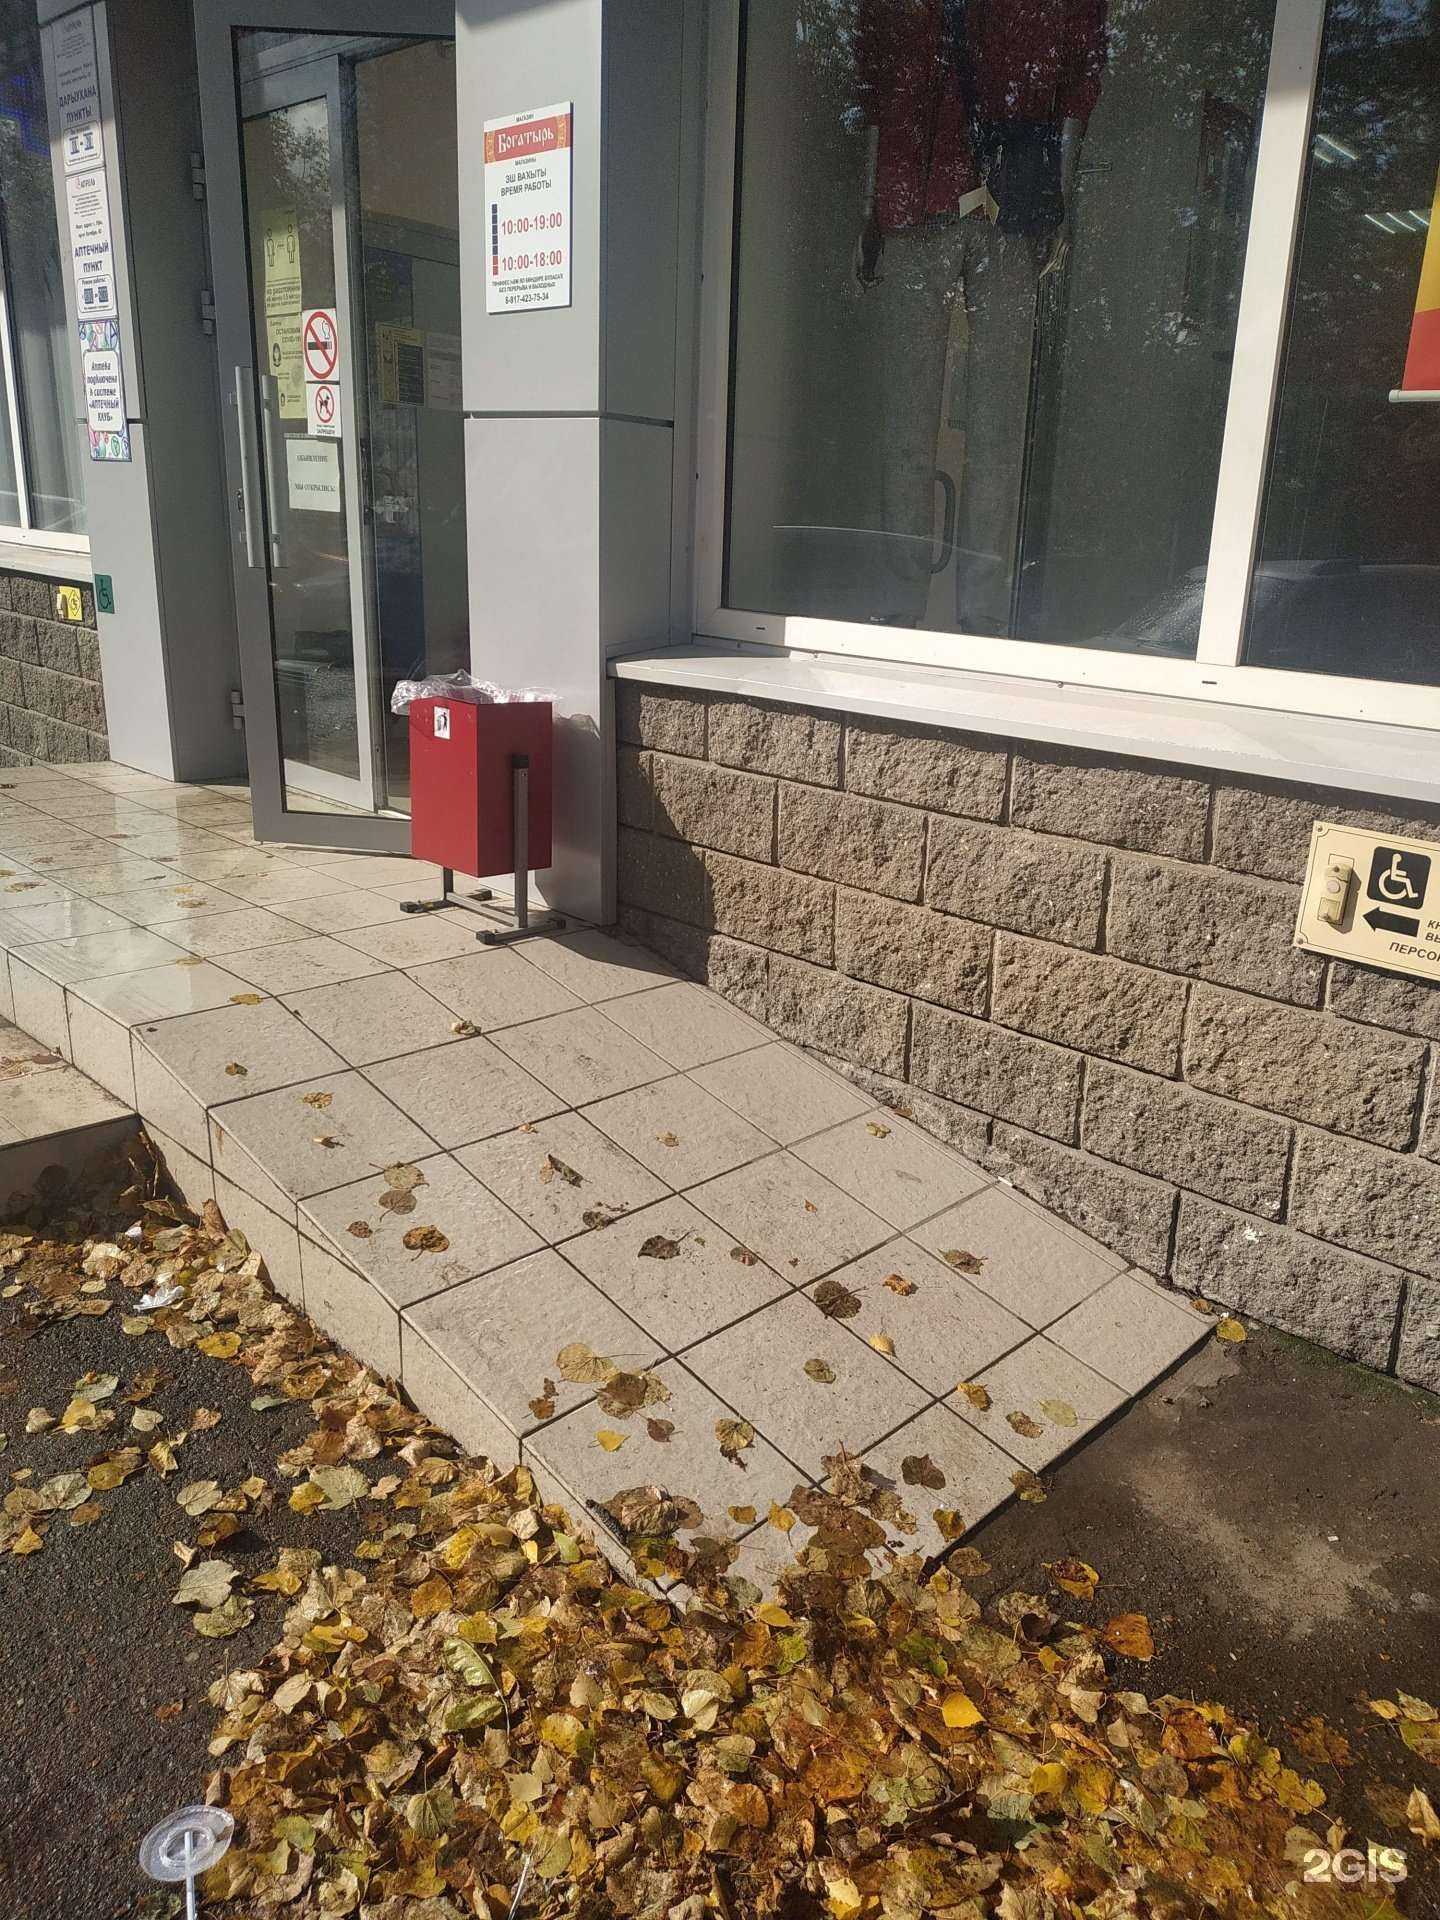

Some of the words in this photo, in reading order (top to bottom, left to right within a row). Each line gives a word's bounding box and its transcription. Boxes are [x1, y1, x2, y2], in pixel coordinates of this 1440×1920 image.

[66, 105, 91, 122] ПУНКТЫ
[498, 127, 554, 153] Богатырь
[505, 173, 516, 183] ЭШ
[501, 184, 523, 197] ВРЕМЯ
[524, 179, 552, 192] РАБОТЫ
[502, 212, 562, 235] 10:00-19:00
[75, 240, 109, 257] АПТЕЧНЫЙ
[83, 260, 103, 273] ПУНКТ
[502, 250, 562, 271] 10:00-18:00
[87, 374, 117, 385] подключена
